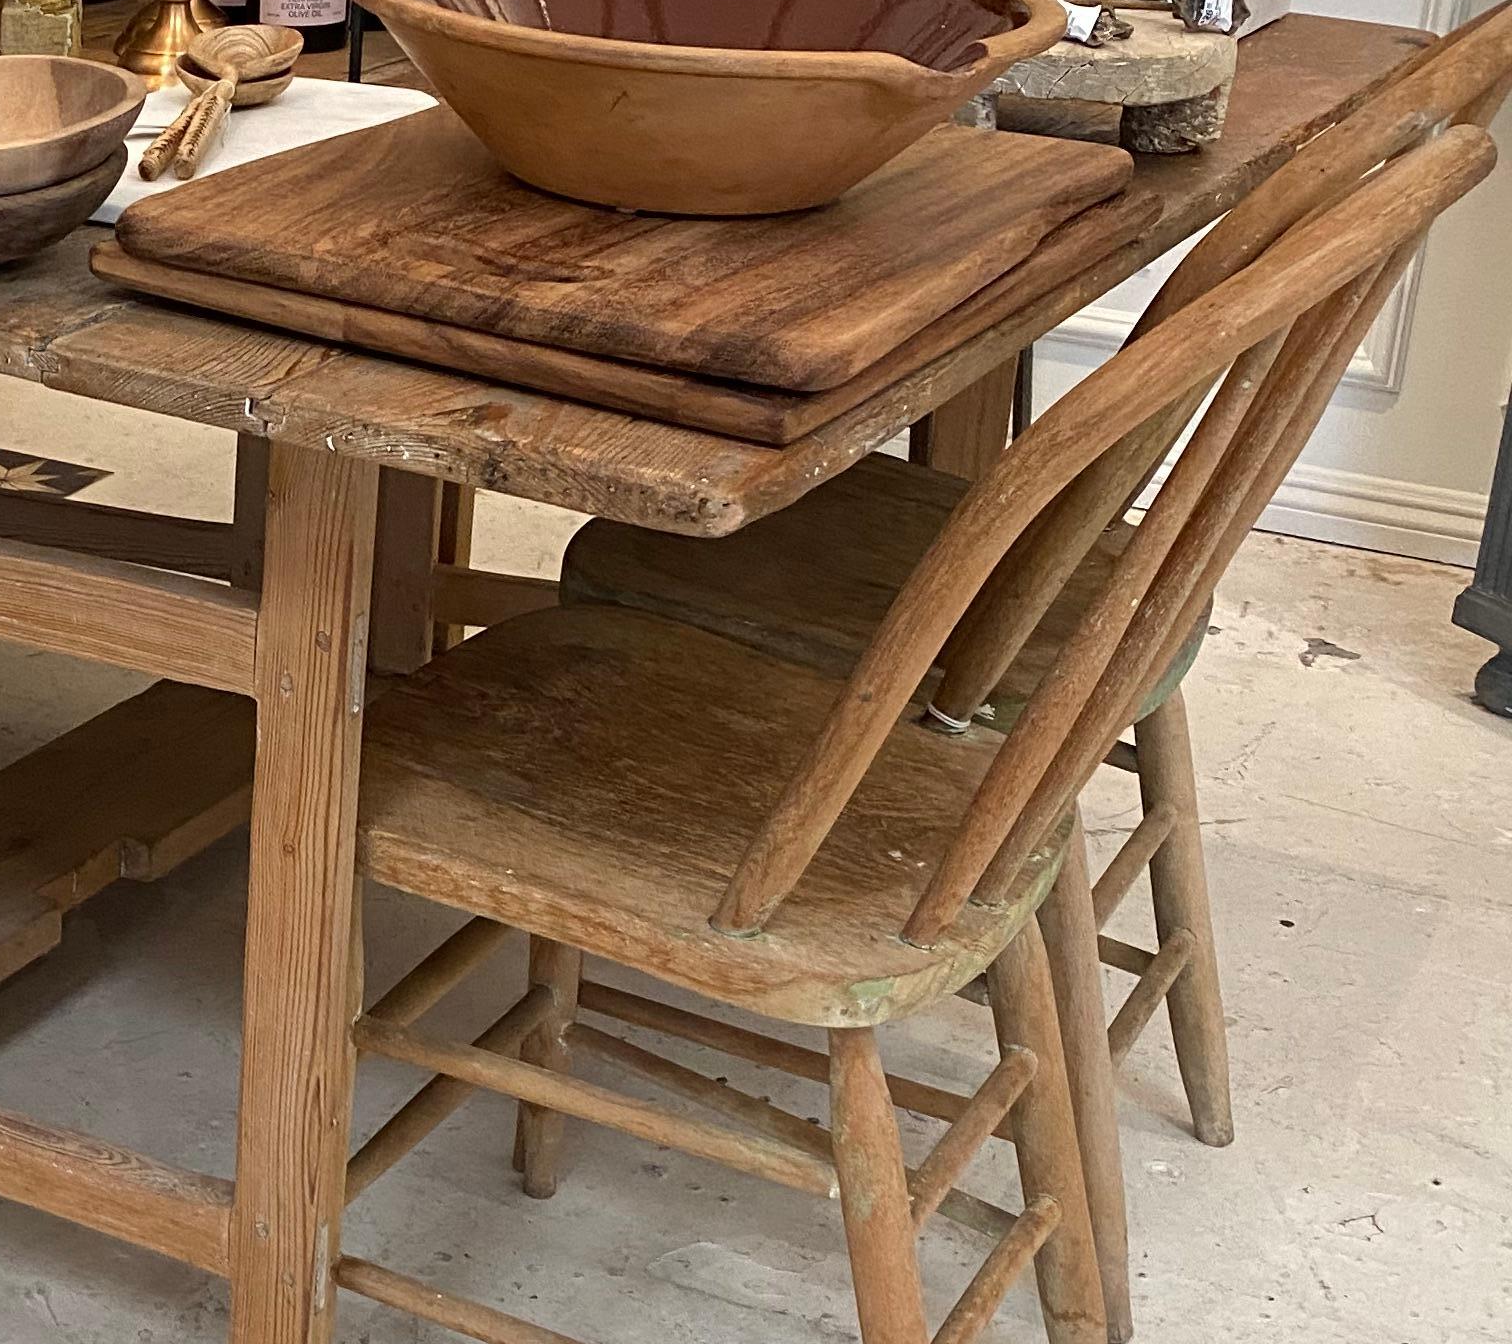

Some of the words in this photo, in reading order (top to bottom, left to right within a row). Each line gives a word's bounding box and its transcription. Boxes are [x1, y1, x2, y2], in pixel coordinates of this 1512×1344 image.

[281, 2, 306, 10] EXTRA
[306, 1, 331, 10] VIRGIN
[288, 10, 309, 18] OLIVE
